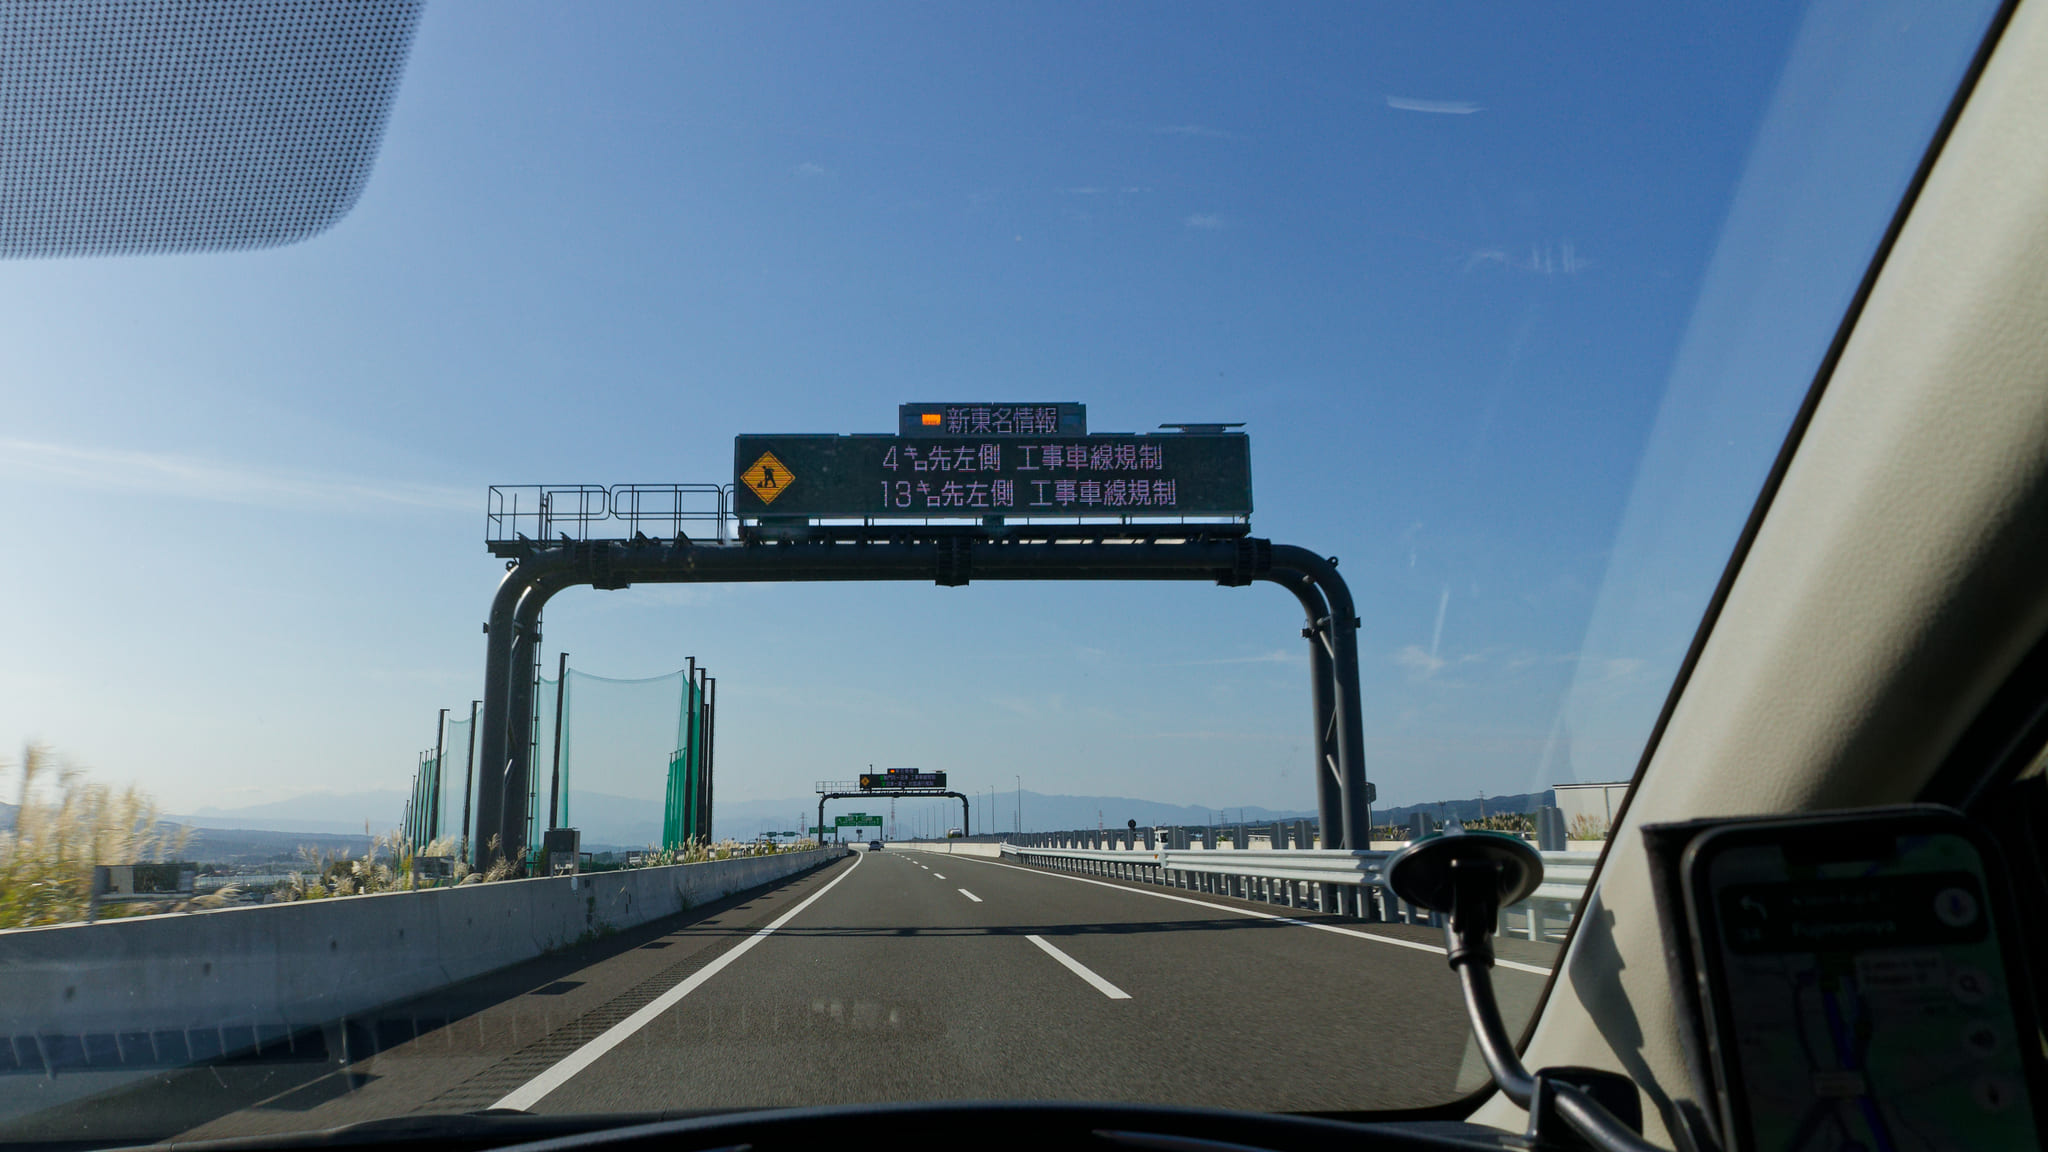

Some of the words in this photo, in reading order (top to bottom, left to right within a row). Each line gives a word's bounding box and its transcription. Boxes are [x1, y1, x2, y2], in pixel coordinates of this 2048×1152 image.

[947, 408, 1057, 434] 新東名情報
[1017, 443, 1162, 470] 工事車線規制
[1029, 479, 1176, 506] 工事車線規制
